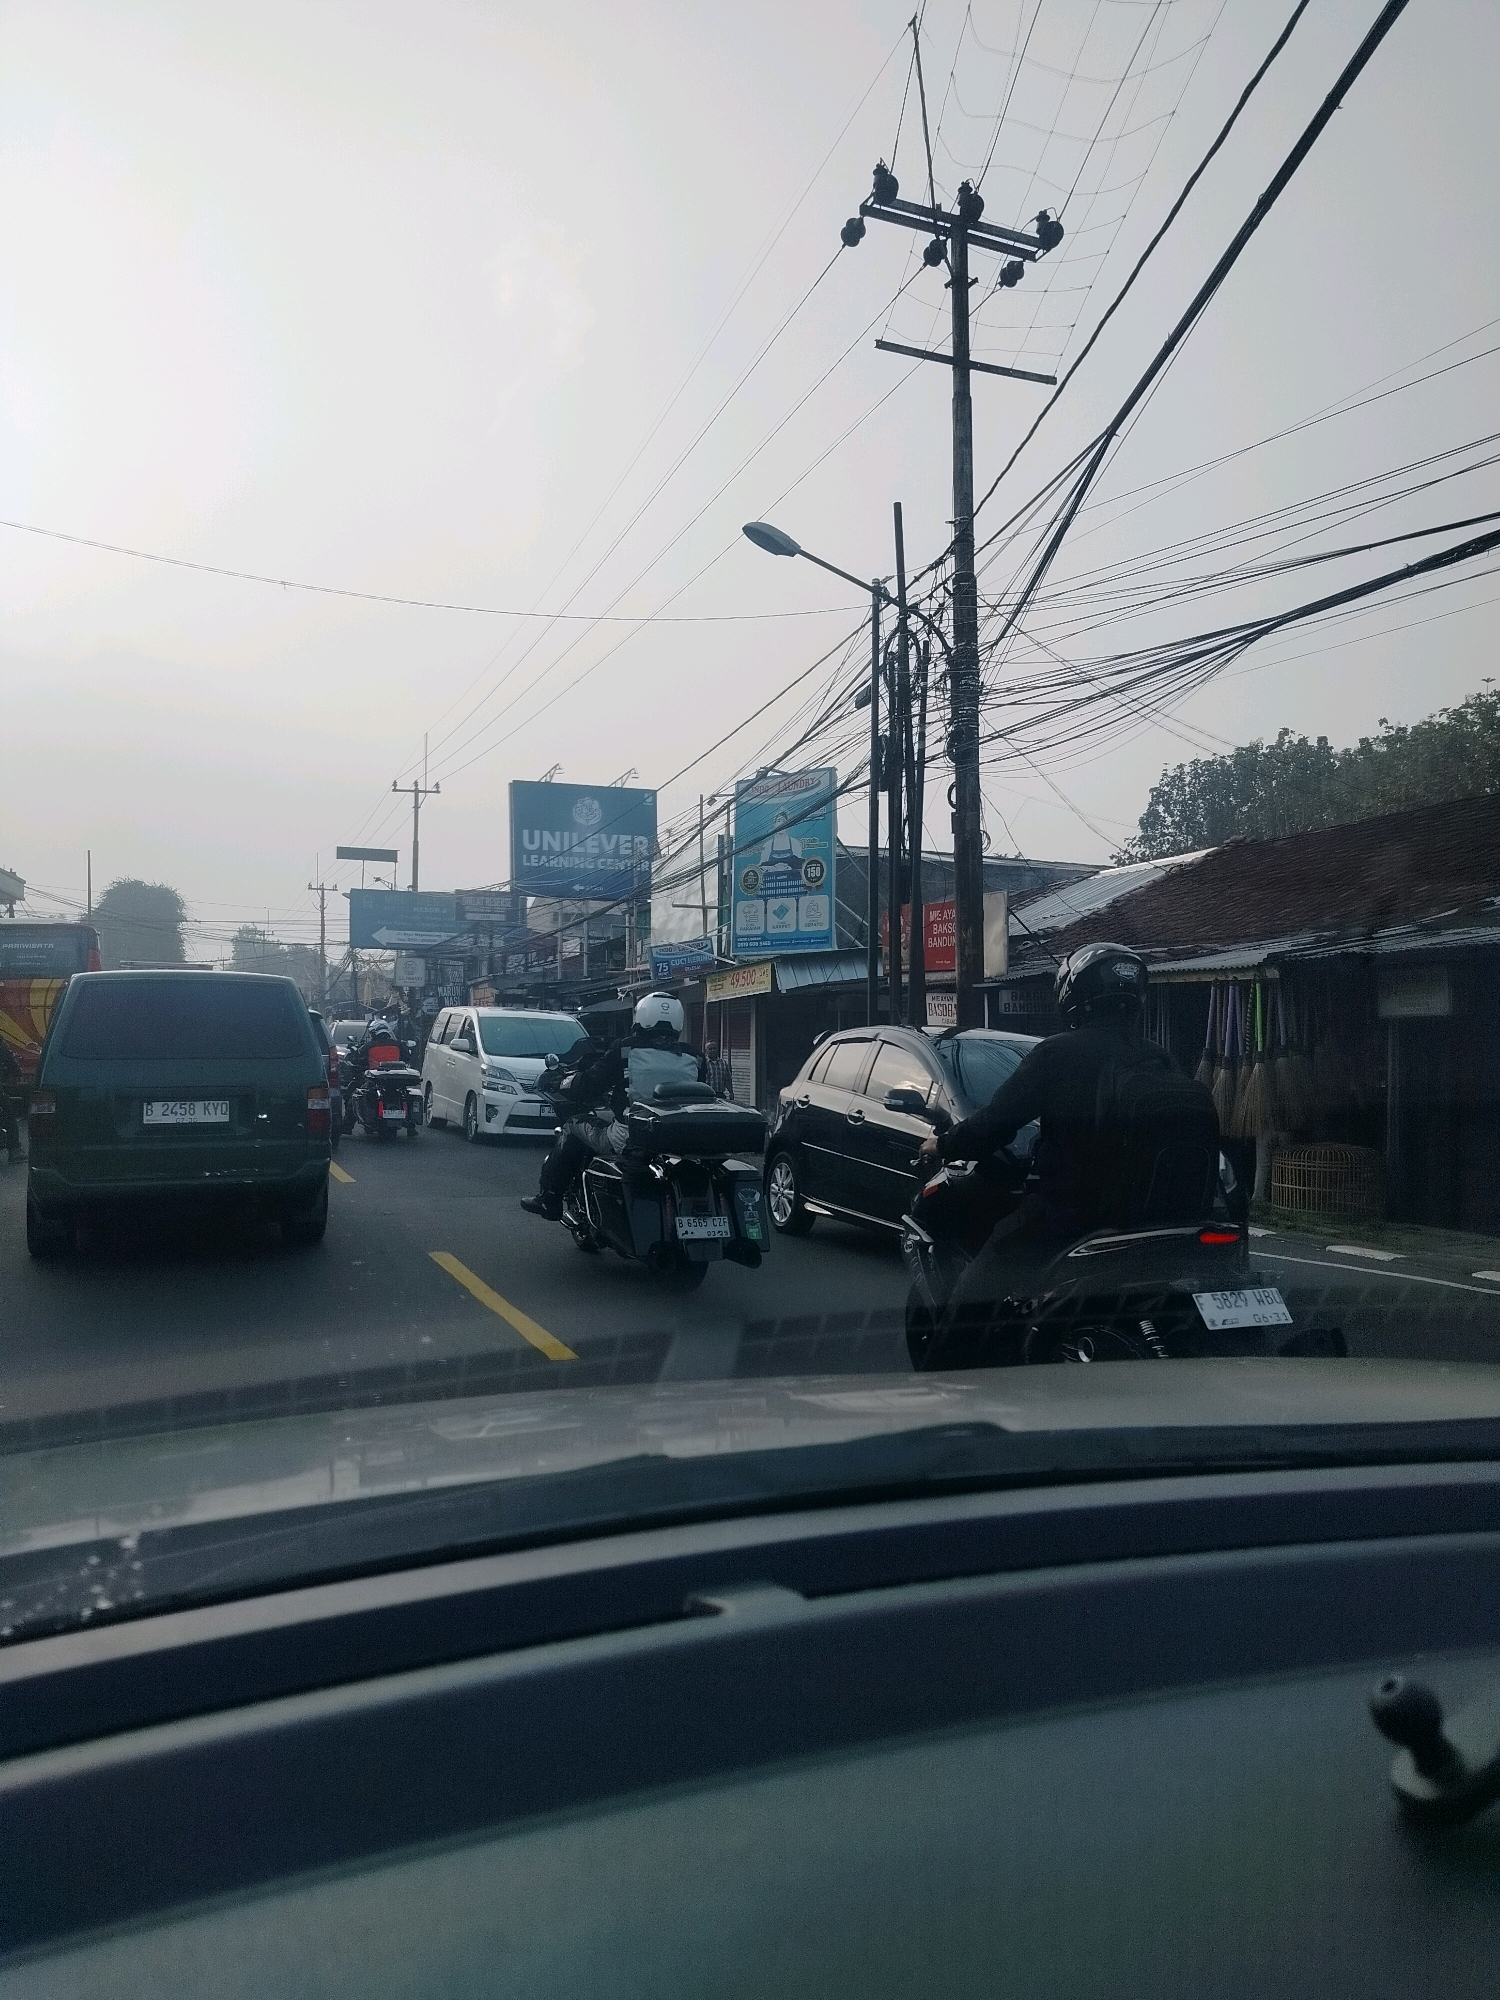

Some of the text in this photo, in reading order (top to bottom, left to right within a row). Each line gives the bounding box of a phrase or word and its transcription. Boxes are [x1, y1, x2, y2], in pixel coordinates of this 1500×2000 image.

[522, 829, 650, 856] UNILEVER
[522, 854, 651, 872] LEARNING CENTER
[806, 867, 822, 878] 150
[656, 962, 669, 973] 75
[145, 1101, 229, 1117] B 2458 KYQ
[678, 1218, 684, 1228] B
[686, 1217, 708, 1228] 6565
[1195, 1289, 1285, 1312] F 5829 WBU
